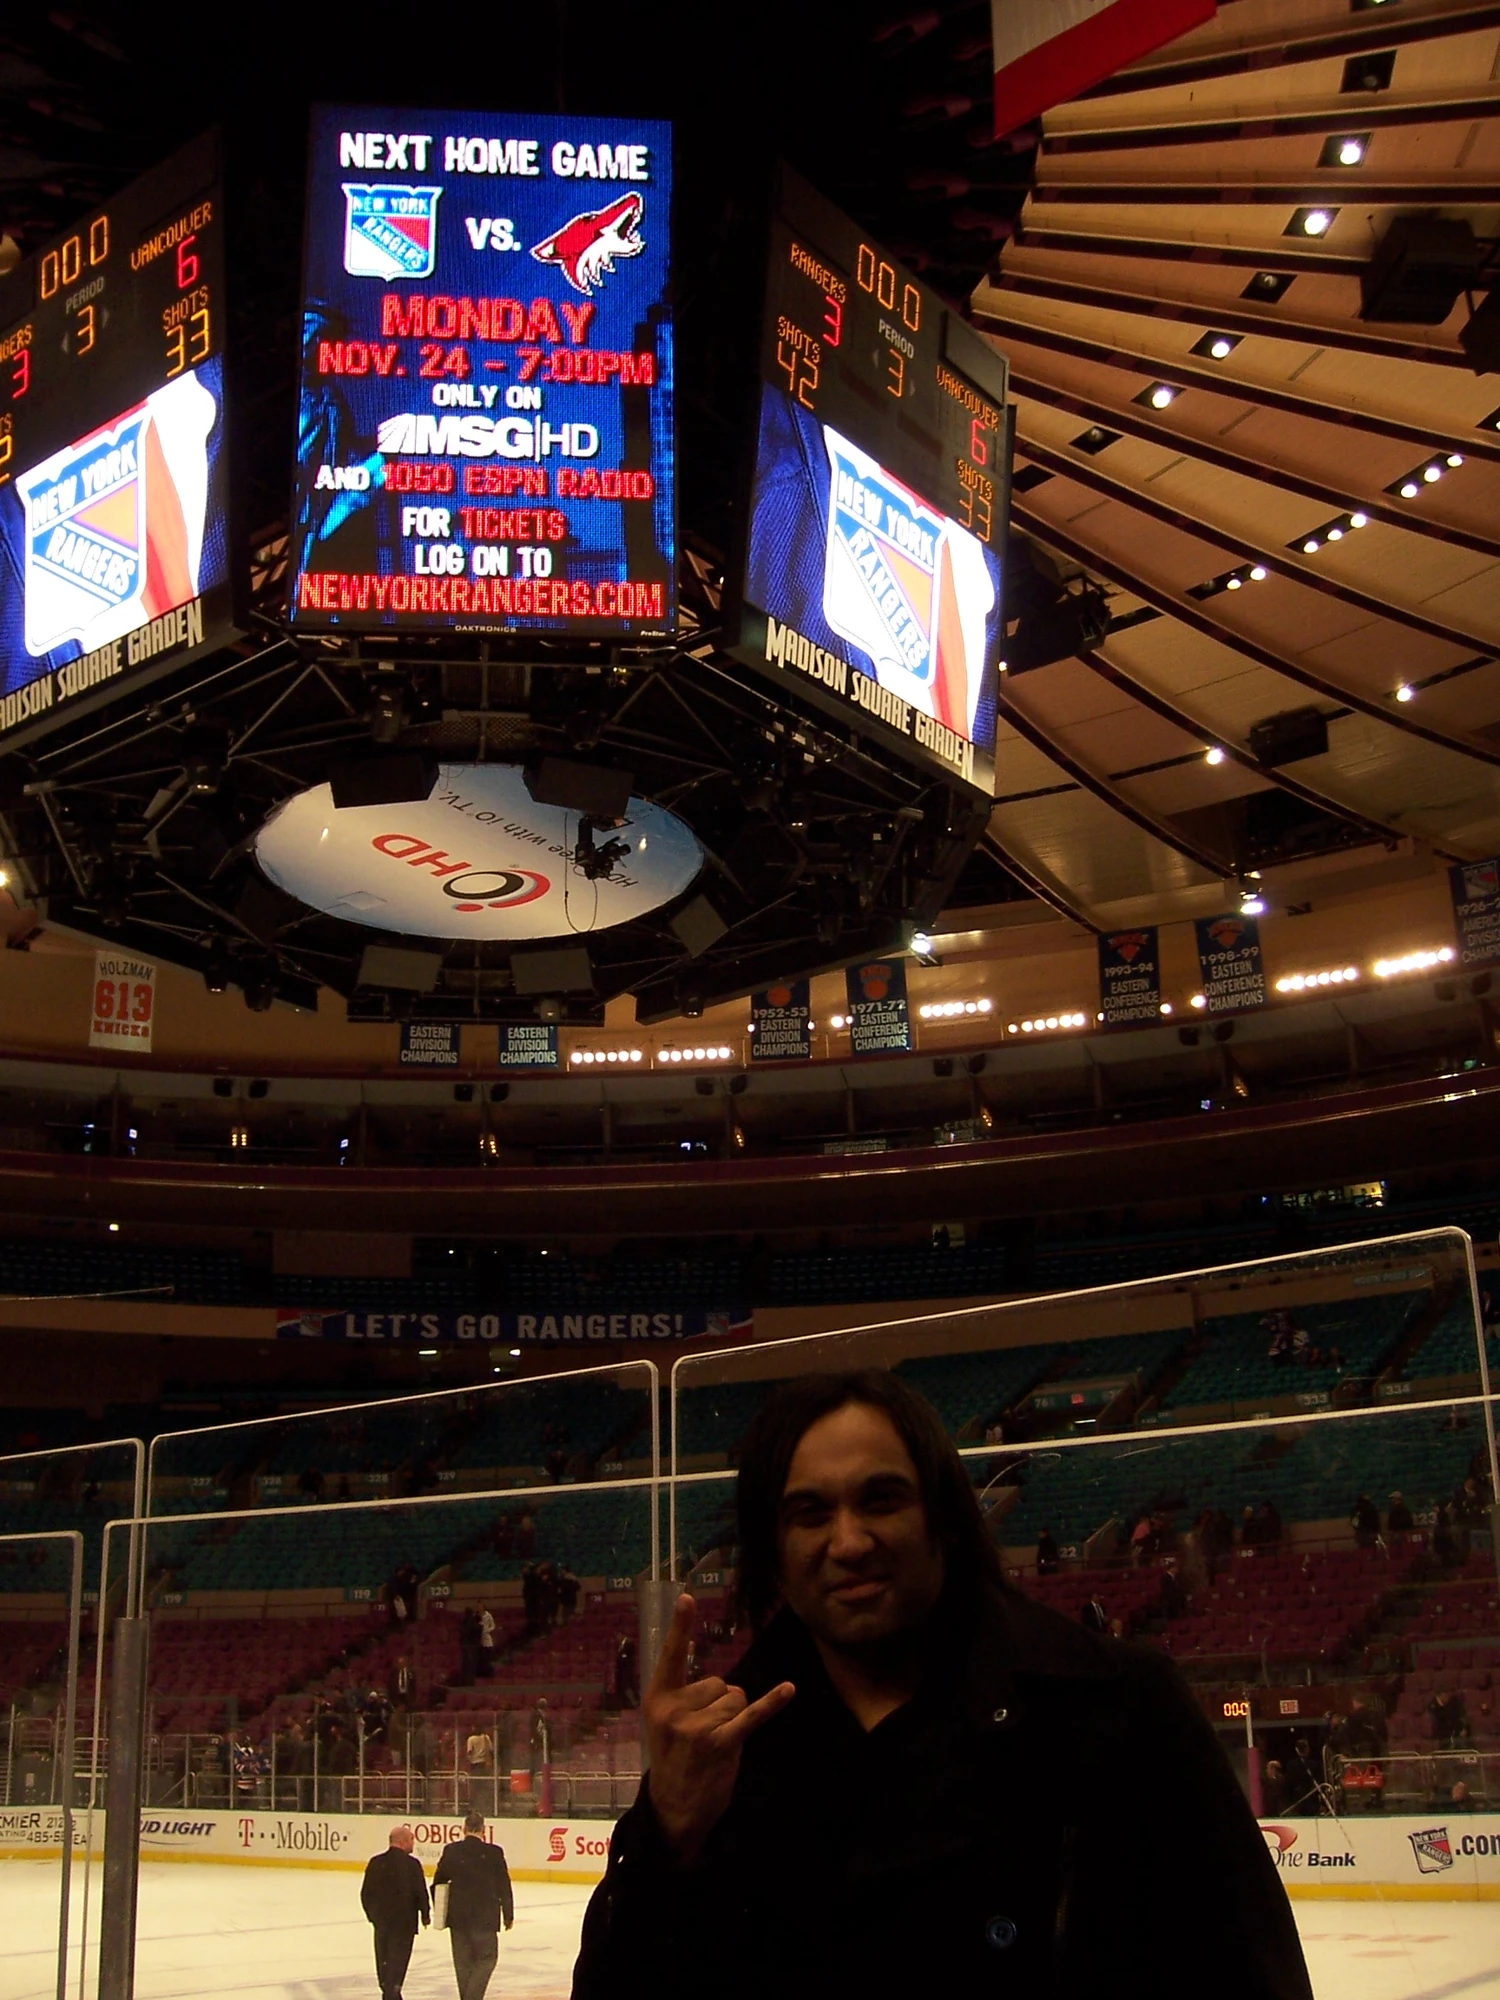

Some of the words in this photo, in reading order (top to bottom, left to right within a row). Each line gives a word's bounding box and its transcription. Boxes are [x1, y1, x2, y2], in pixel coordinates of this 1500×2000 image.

[340, 132, 432, 171] NEXT
[445, 136, 540, 176] HOME
[552, 141, 649, 180] GAME
[353, 195, 384, 213] NEW
[391, 196, 428, 214] YORK
[131, 201, 212, 270] VANCOUVER
[362, 215, 425, 270] RANGERS
[465, 217, 521, 252] VS.
[177, 235, 198, 289] 6
[790, 242, 847, 304] RANGERS
[66, 276, 105, 315] PERIOD
[162, 285, 209, 331] SHOTS
[77, 304, 95, 356] 3
[382, 294, 595, 343] MONDAY
[823, 295, 841, 347] 3
[165, 307, 210, 378] 33
[777, 316, 821, 363] SHOTS
[878, 318, 915, 359] PERIOD
[12, 349, 30, 400] 3
[317, 341, 407, 377] NOV.
[419, 345, 470, 379] 24
[515, 347, 655, 386] 7:00PM
[777, 340, 819, 411] 42
[886, 348, 904, 398] 3
[432, 383, 498, 409] ONLY
[506, 386, 542, 411] ON
[936, 364, 999, 433] VANCOUVER
[971, 418, 987, 466] 6
[33, 474, 78, 529] NEW
[81, 440, 135, 498] YORK
[314, 464, 370, 491] AND
[382, 463, 455, 494] 1050
[464, 466, 548, 497] ESPN
[556, 467, 655, 499] RADIO
[957, 458, 993, 500] SHOTS
[402, 507, 451, 538] FOR
[460, 507, 566, 541] TICKETS
[837, 470, 884, 528] NEW
[886, 504, 936, 567] YORK
[958, 480, 992, 550] 33
[45, 525, 136, 596] RANGERS
[414, 545, 465, 576] LOG
[473, 546, 509, 577] ON
[516, 548, 553, 578] TO
[300, 572, 664, 618] NEWYORKRANGERS.COM
[849, 527, 931, 669] RANGERS
[455, 625, 518, 634] DAKTRONICS
[57, 638, 123, 702] SQUARE
[127, 597, 206, 667] GARDEN
[765, 615, 848, 696] MADISON
[850, 670, 912, 735] SQUARE
[914, 709, 975, 782] GARDEN
[503, 823, 548, 846] with
[371, 833, 472, 877] HD
[99, 959, 155, 981] HOLZMAN
[1104, 962, 1154, 978] 1993-94
[1200, 946, 1260, 965] 1998-99
[1211, 961, 1253, 979] EASTERN
[94, 979, 153, 1022] 613
[1104, 992, 1159, 1009] CONFERENCE
[1111, 978, 1149, 994] EASTERN
[1204, 974, 1265, 997] CONFERENCE
[1209, 990, 1264, 1012] CHAMPIONS
[753, 1007, 809, 1019] 1952-53
[851, 999, 907, 1014] 1971-72
[860, 1011, 898, 1026] EASTERN
[1107, 1006, 1157, 1023] CHAMPIONS
[92, 1020, 150, 1037] KNICKS
[410, 1025, 451, 1038] EASTERN
[507, 1026, 548, 1039] EASTERN
[760, 1018, 800, 1031] EASTERN
[761, 1030, 800, 1044] DIVISION
[852, 1022, 909, 1039] CONFERENCE
[401, 1050, 458, 1064] CHAMPIONS
[410, 1038, 450, 1051] DIVISION
[500, 1051, 557, 1064] CHAMPIONS
[508, 1038, 548, 1051] DIVISION
[753, 1042, 809, 1057] CHAMPIONS
[855, 1035, 907, 1051] CHAMPIONS
[346, 1313, 439, 1339] LET'S
[457, 1314, 500, 1339] GO
[518, 1313, 684, 1339] RANGERS!
[430, 1585, 451, 1597] 120
[612, 1577, 633, 1589] 120
[163, 1820, 216, 1836] LIGHT
[1307, 1852, 1356, 1867] Bank
